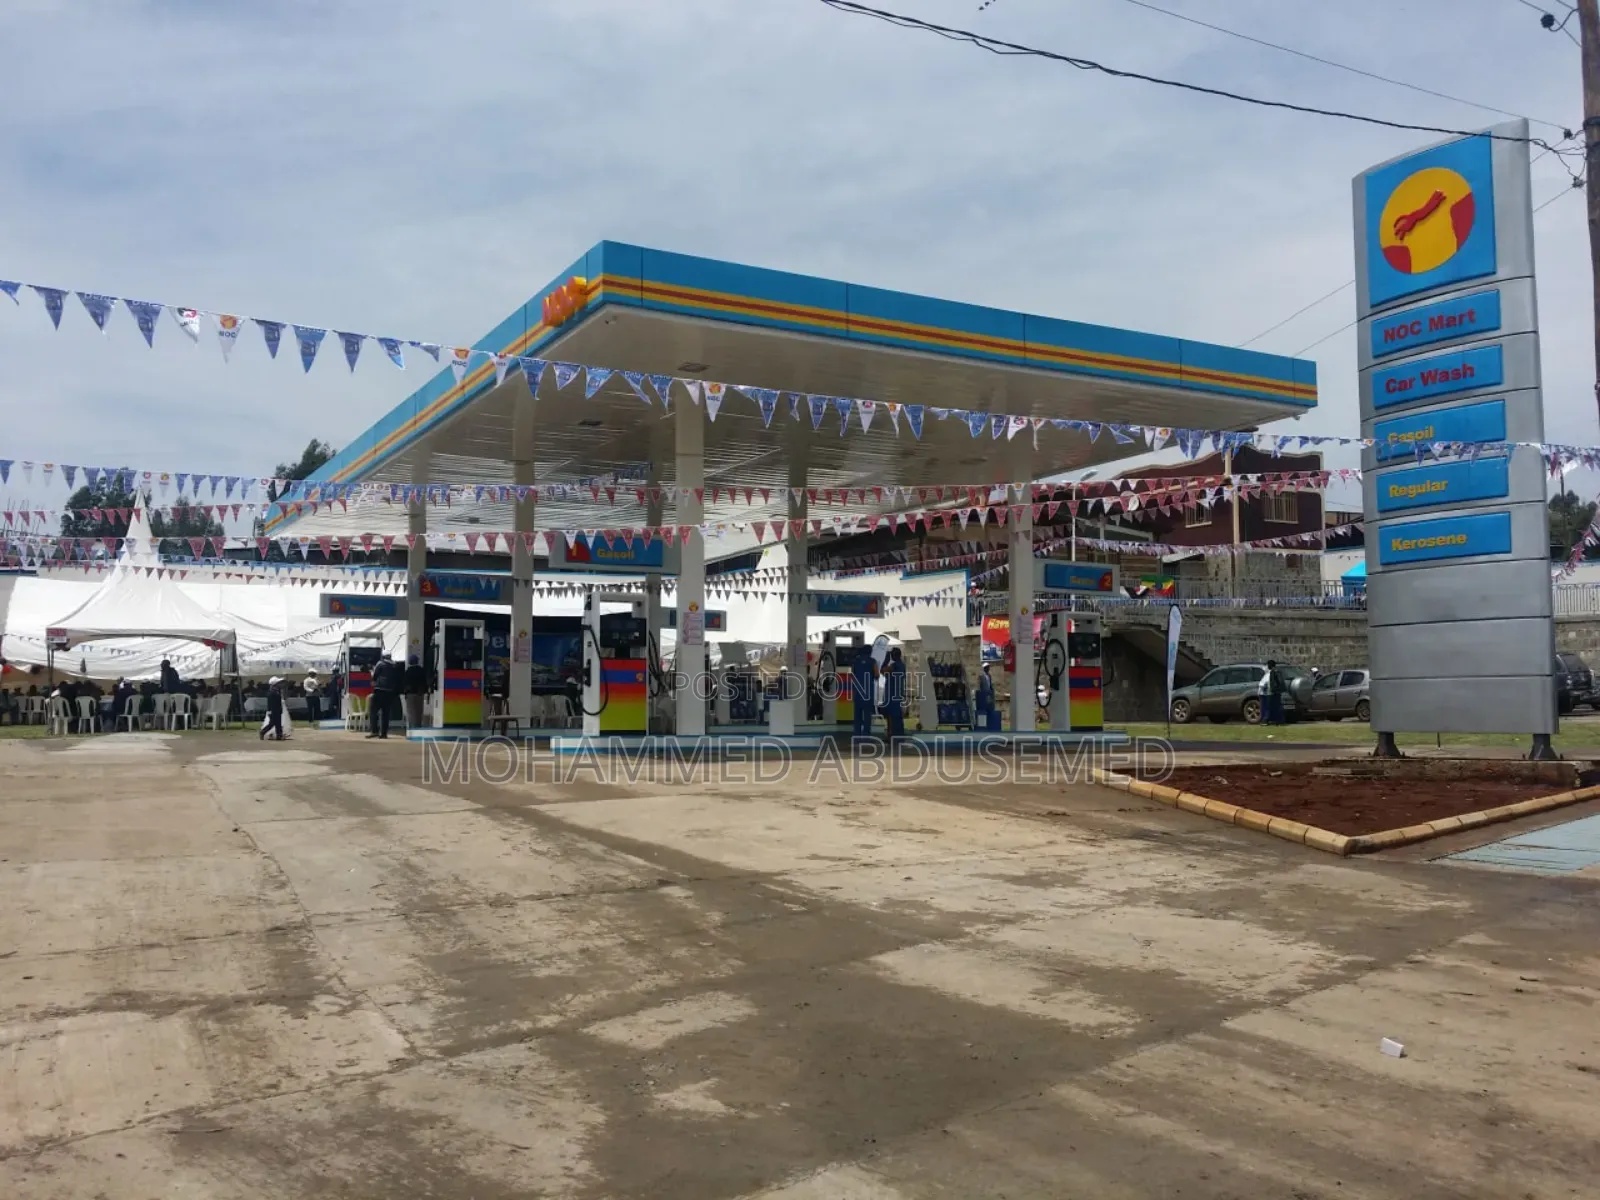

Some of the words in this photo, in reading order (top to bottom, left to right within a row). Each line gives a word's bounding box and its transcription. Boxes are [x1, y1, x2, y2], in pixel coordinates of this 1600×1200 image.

[1384, 320, 1422, 343] NOC
[1429, 308, 1476, 332] Mart
[1385, 377, 1416, 394] Car
[1420, 363, 1475, 386] Wash
[1389, 480, 1449, 499] Regular
[1391, 533, 1468, 551] Kerosene
[423, 581, 432, 593] 3
